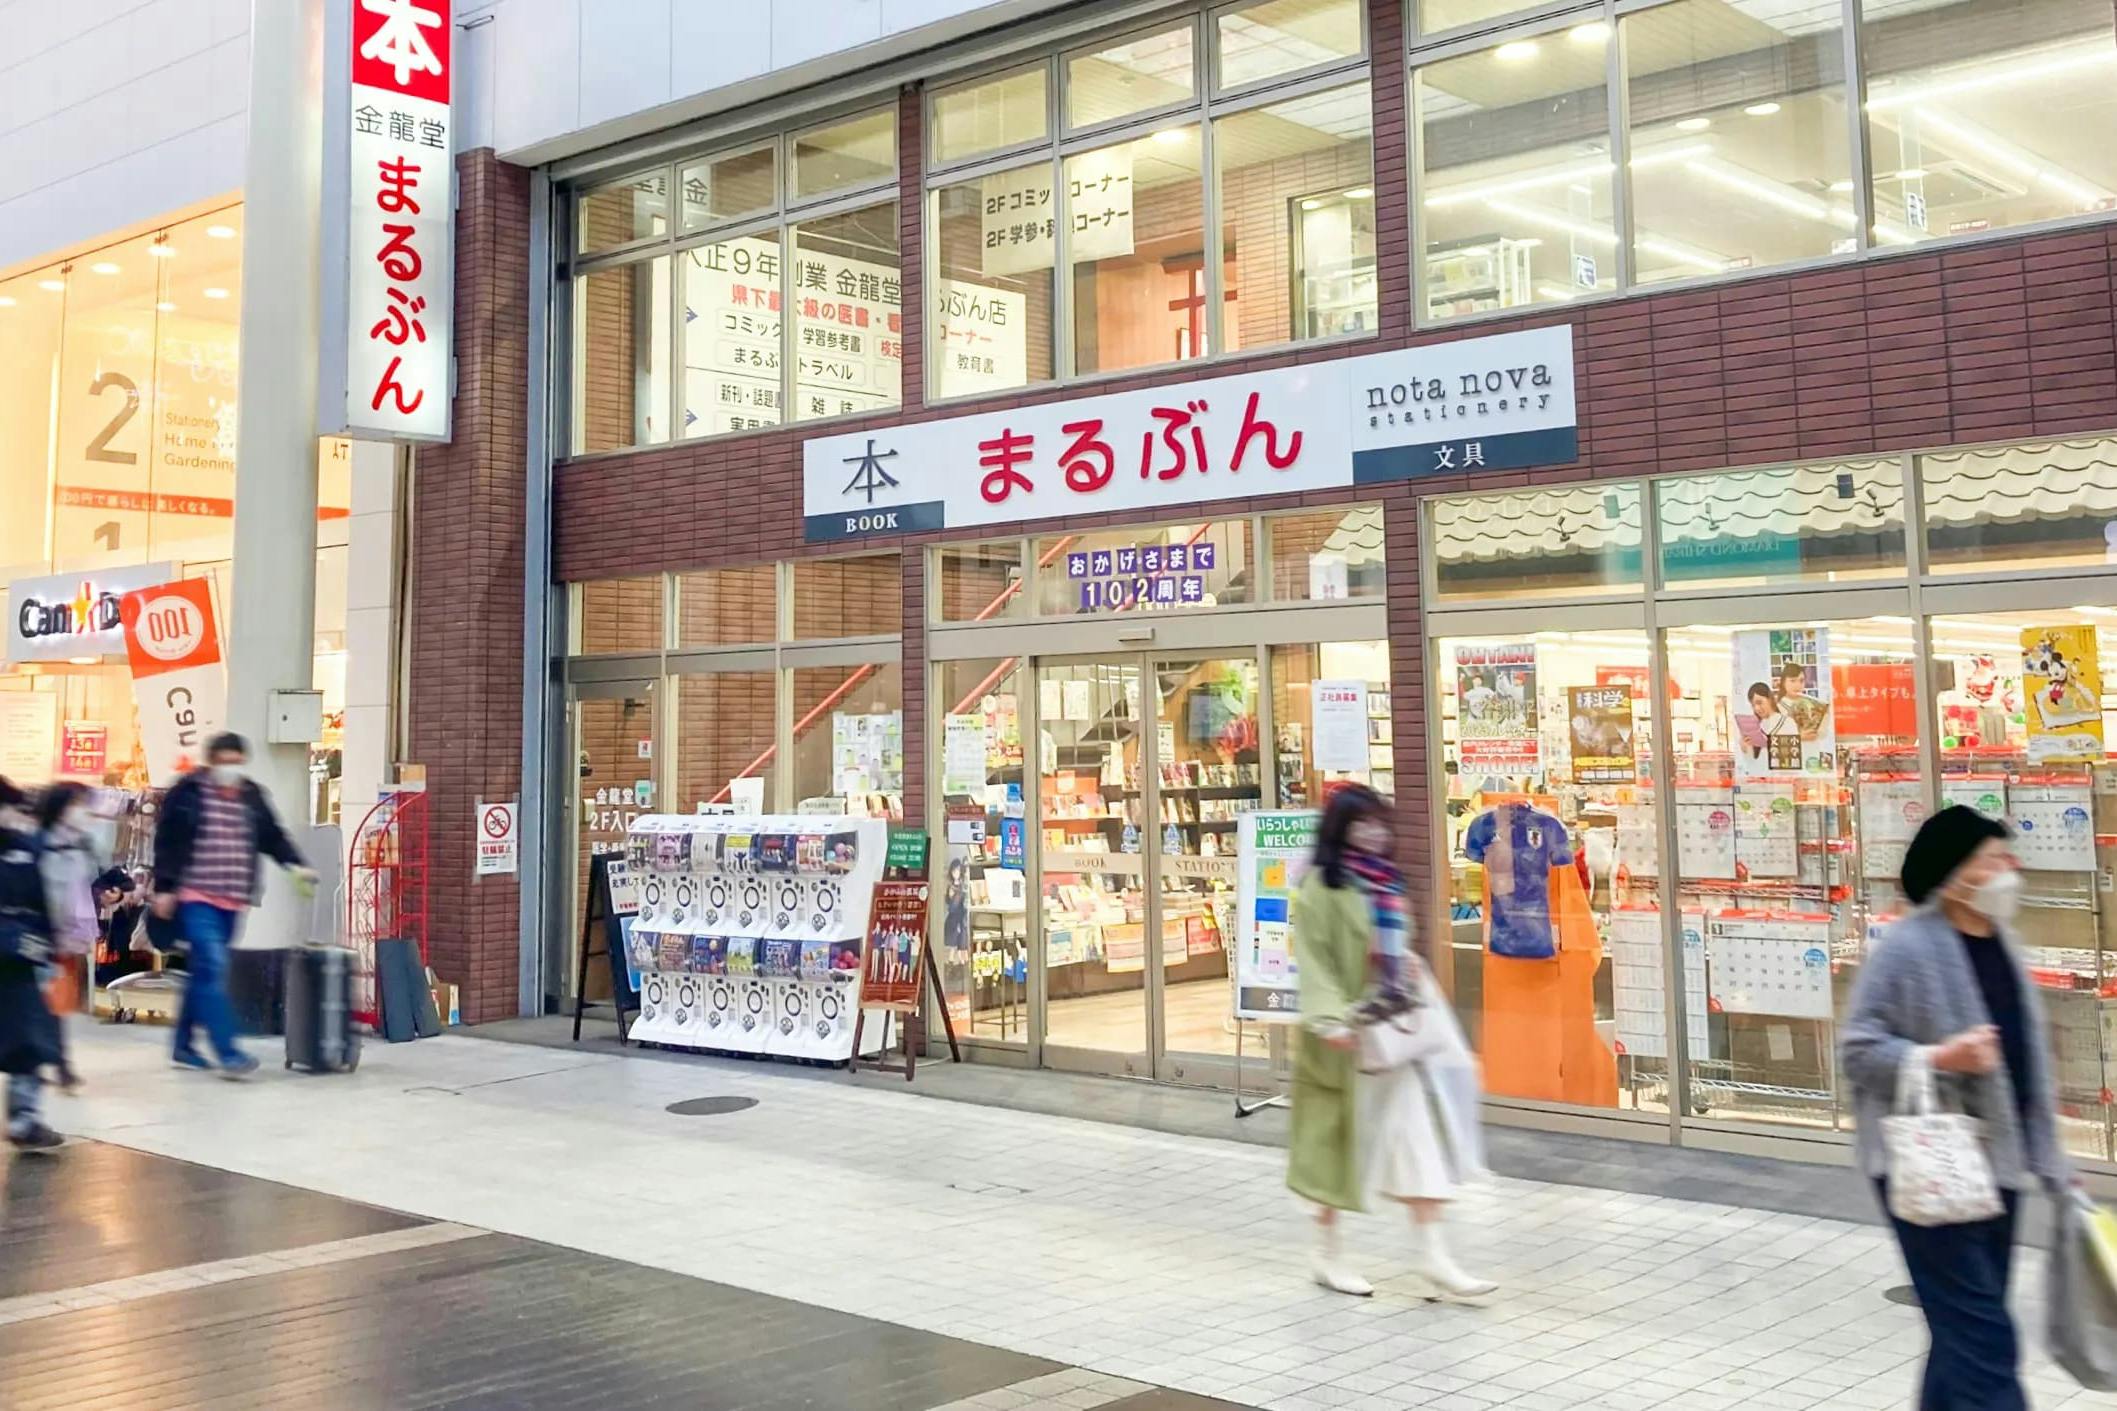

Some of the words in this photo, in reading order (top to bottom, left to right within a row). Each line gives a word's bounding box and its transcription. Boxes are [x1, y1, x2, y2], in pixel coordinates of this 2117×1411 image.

[360, 0, 443, 86] 本
[355, 105, 445, 149] 金龍堂
[986, 195, 1006, 215] 2F
[1010, 173, 1129, 210] コミッコーナー
[986, 229, 1006, 248] 2F
[1009, 208, 1129, 245] 学参・コーナー
[371, 156, 427, 415] まるぶん
[803, 327, 861, 353] 学習参考書
[734, 347, 853, 381] まるぶトラベル
[721, 384, 776, 408] 新刊・話題
[1367, 376, 1446, 409] nota
[1459, 364, 1551, 396] nova
[86, 373, 140, 465] 2
[1369, 393, 1550, 427] stationery
[977, 391, 1304, 505] まるぶん
[1434, 443, 1485, 470] 文具
[841, 439, 899, 504] 本
[845, 512, 899, 533] BOOK
[1071, 547, 1212, 575] おかげさまで
[1087, 577, 1201, 606] 102周年
[1257, 817, 1313, 832] いらっしゃい
[1263, 833, 1315, 848] WELCO
